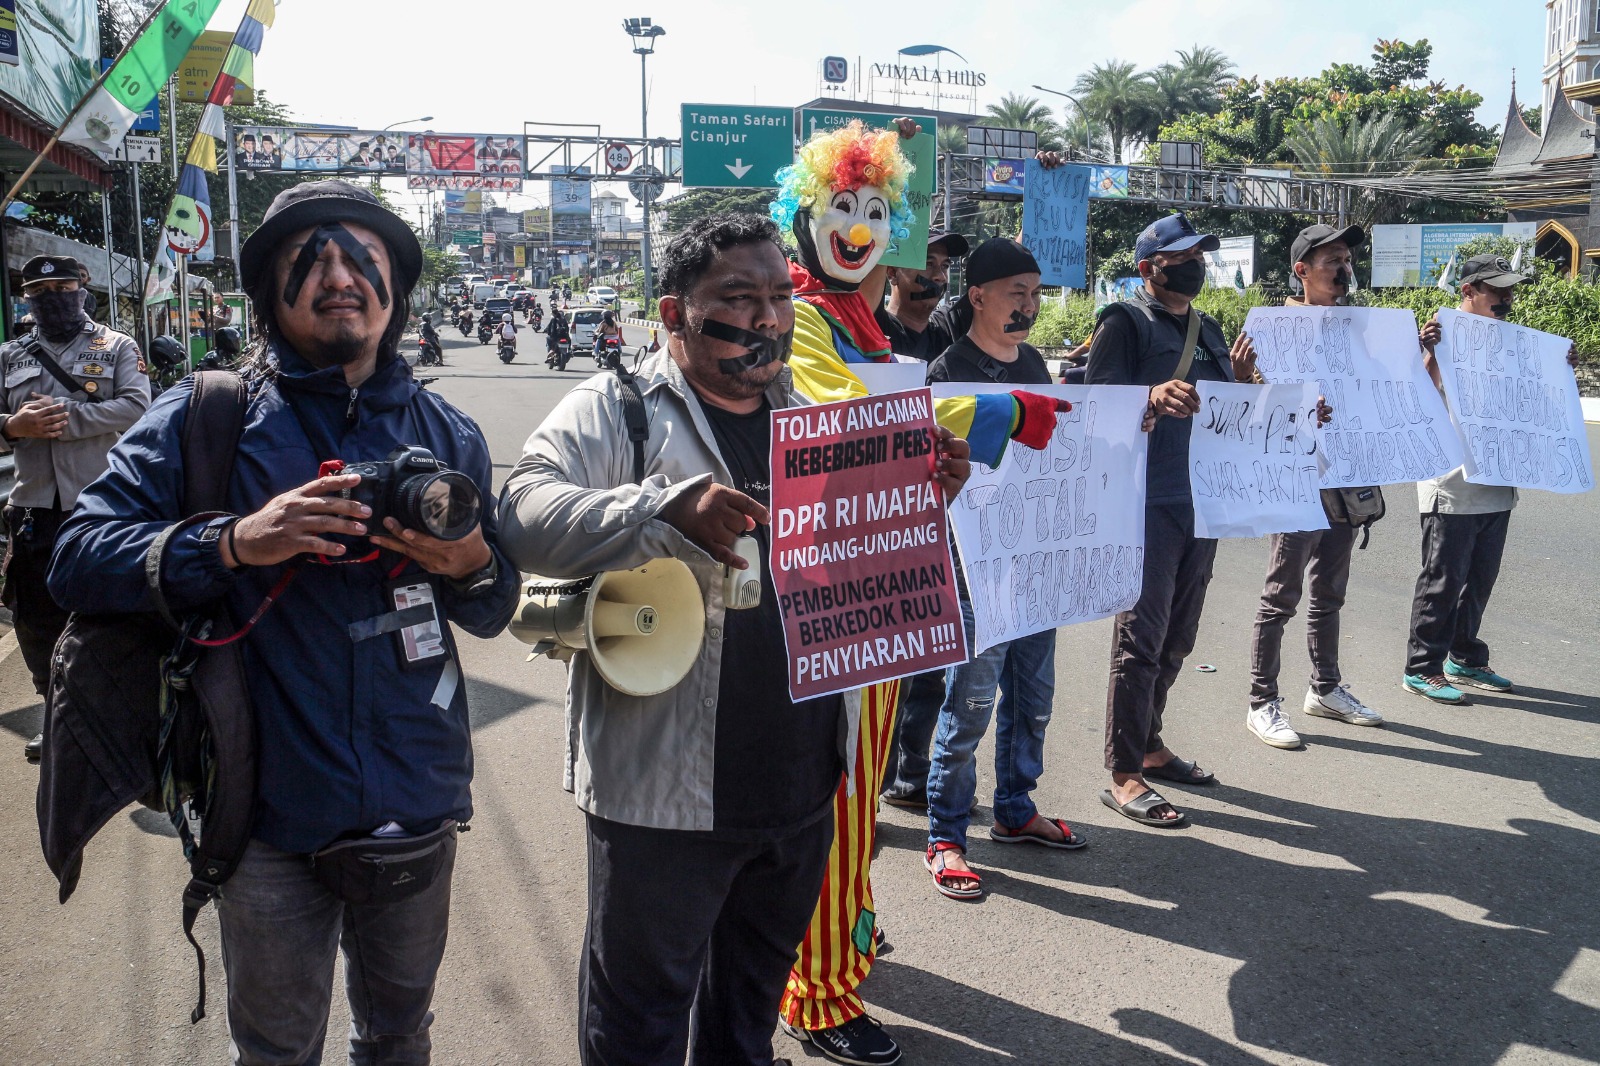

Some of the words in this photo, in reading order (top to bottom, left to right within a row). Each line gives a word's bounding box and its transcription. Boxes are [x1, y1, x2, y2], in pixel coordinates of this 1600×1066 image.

[120, 75, 140, 96] 10
[184, 66, 208, 77] atm
[690, 113, 738, 125] Taman
[744, 114, 787, 127] Safari
[690, 131, 748, 146] Cianjur
[995, 166, 1013, 174] Hydro
[1029, 168, 1089, 203] REVISI
[1034, 199, 1077, 234] RUU
[78, 353, 116, 362] POLISI
[776, 409, 843, 442] TOLAK
[846, 395, 929, 433] ANCAMAN
[411, 456, 434, 464] Canon
[785, 434, 888, 479] KEBEBASAN
[892, 427, 932, 461] PERS
[777, 500, 827, 539] DPR
[835, 495, 858, 528] RI
[866, 480, 938, 521] MAFIA
[779, 522, 939, 572] UNDANG-UNDANG
[780, 563, 947, 619] PEMBUNGKAMAN
[798, 603, 897, 647] BERKEDOK
[900, 592, 943, 623] RUU
[796, 629, 926, 685] PENYIARAN
